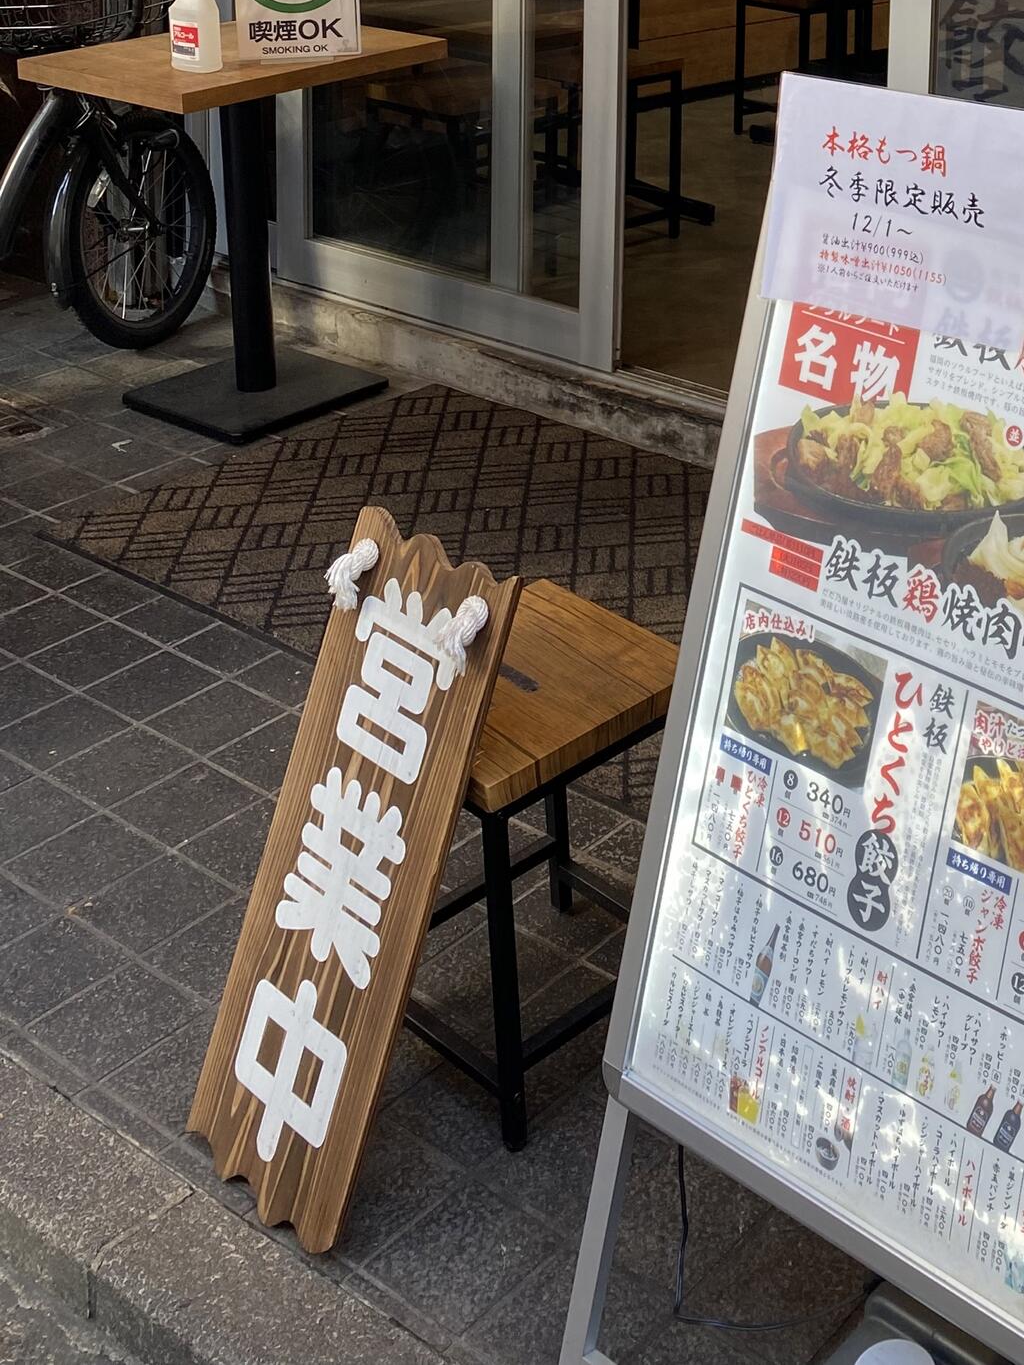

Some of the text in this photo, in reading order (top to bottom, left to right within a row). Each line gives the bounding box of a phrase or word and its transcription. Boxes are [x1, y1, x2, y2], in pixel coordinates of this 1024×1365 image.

[249, 18, 343, 42] 喫煙OK
[262, 44, 328, 55] SMOKING OK
[822, 126, 947, 177] 本格もつ鍋
[819, 166, 985, 228] 冬季限定販売
[794, 324, 900, 402] 名物
[825, 540, 1022, 660] 鉄板鶏焼肉
[923, 684, 955, 754] 鉄板
[723, 738, 768, 769] 持ち帰り専用
[732, 770, 756, 860] ひとくち餃子
[806, 781, 851, 818] 340円
[799, 819, 843, 858] 510円
[233, 576, 470, 1163] 営業中
[792, 861, 836, 897] 680円
[951, 853, 1006, 889] 持ち帰り専用
[967, 889, 994, 985] ジャンボ餃子
[990, 895, 1007, 930] 冷凍
[871, 969, 888, 1013] 酎ハイ
[929, 994, 942, 1026] レモン
[934, 1000, 950, 1051] ハイサワー
[959, 1011, 973, 1052] グレープ
[966, 1016, 982, 1067] ハイサワー
[993, 1029, 1008, 1071] ホッピー
[925, 1128, 944, 1197] コーラハイボール
[942, 1136, 958, 1188] ハイボール
[956, 1158, 978, 1229] ハイボール
